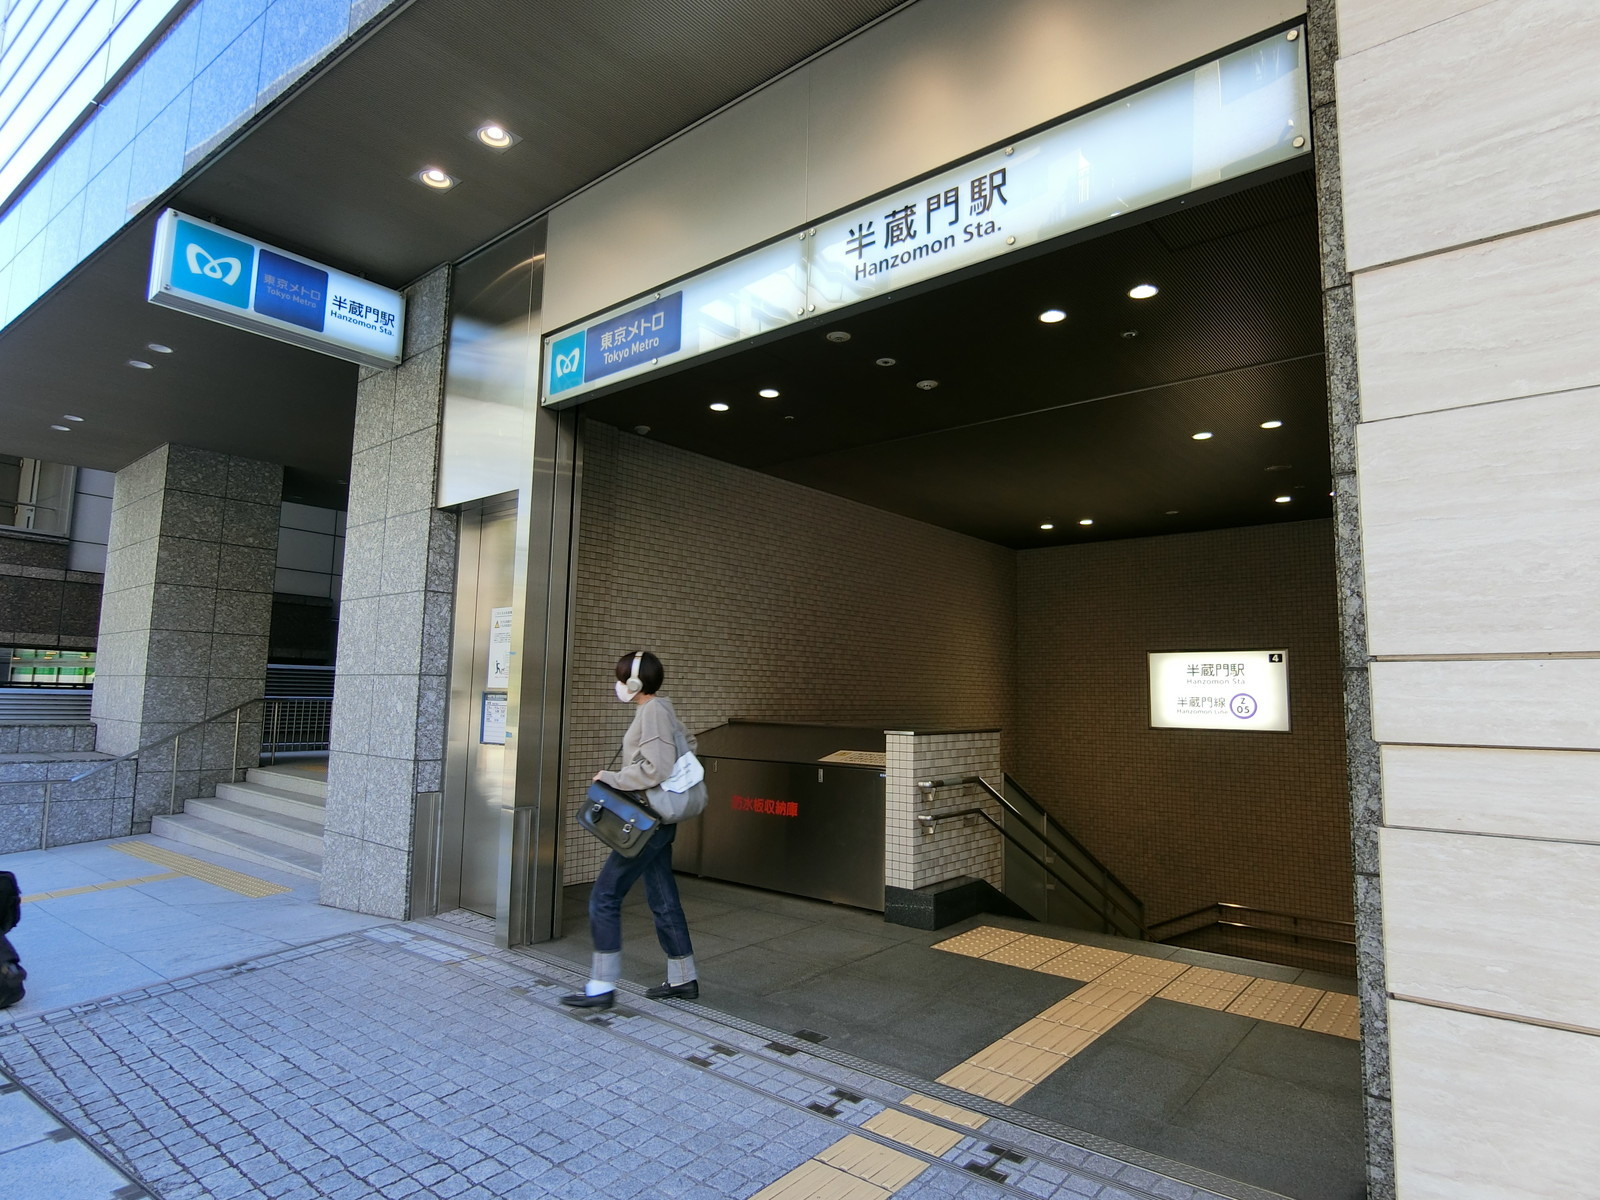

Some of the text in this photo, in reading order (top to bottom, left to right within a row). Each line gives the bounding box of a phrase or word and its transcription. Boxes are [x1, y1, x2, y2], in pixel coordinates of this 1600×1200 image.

[845, 167, 1008, 259] 半蔵門駅
[855, 220, 1002, 280] Hanzomon Sta.
[264, 273, 321, 301] 東京メトロ
[266, 286, 317, 308] Tokyo Metro
[330, 310, 395, 336] Hanzomon Sta.
[332, 294, 395, 328] 半蔵門駅
[600, 312, 665, 351] 東京メトロ
[603, 336, 660, 364] Tokyo Metro
[1186, 663, 1245, 676] 半蔵門駅
[1272, 654, 1279, 662] 4
[1177, 696, 1226, 708] 半蔵門線
[1236, 705, 1250, 714] 05
[1240, 697, 1246, 705] Z
